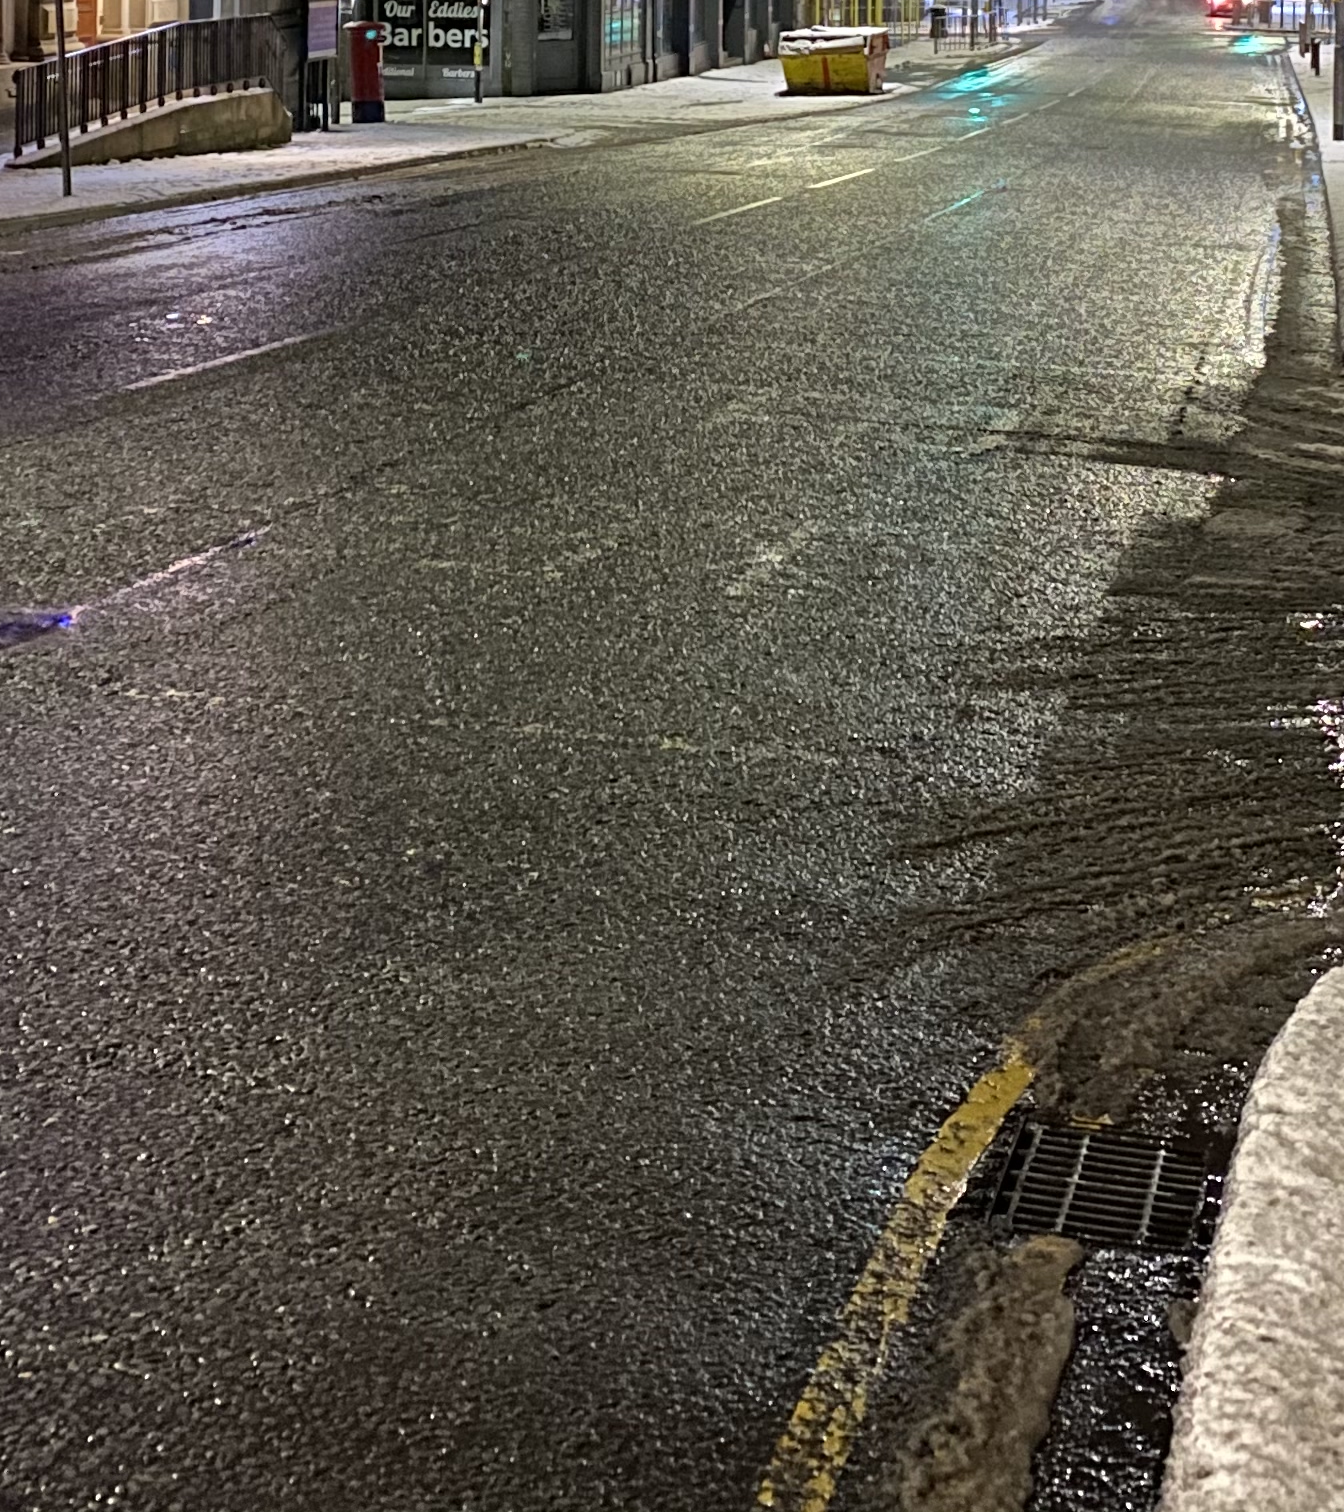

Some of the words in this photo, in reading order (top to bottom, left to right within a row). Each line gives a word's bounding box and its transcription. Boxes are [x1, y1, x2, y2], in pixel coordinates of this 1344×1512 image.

[384, 0, 416, 17] Our
[428, 0, 479, 18] Eddies
[442, 67, 475, 78] Barbers
